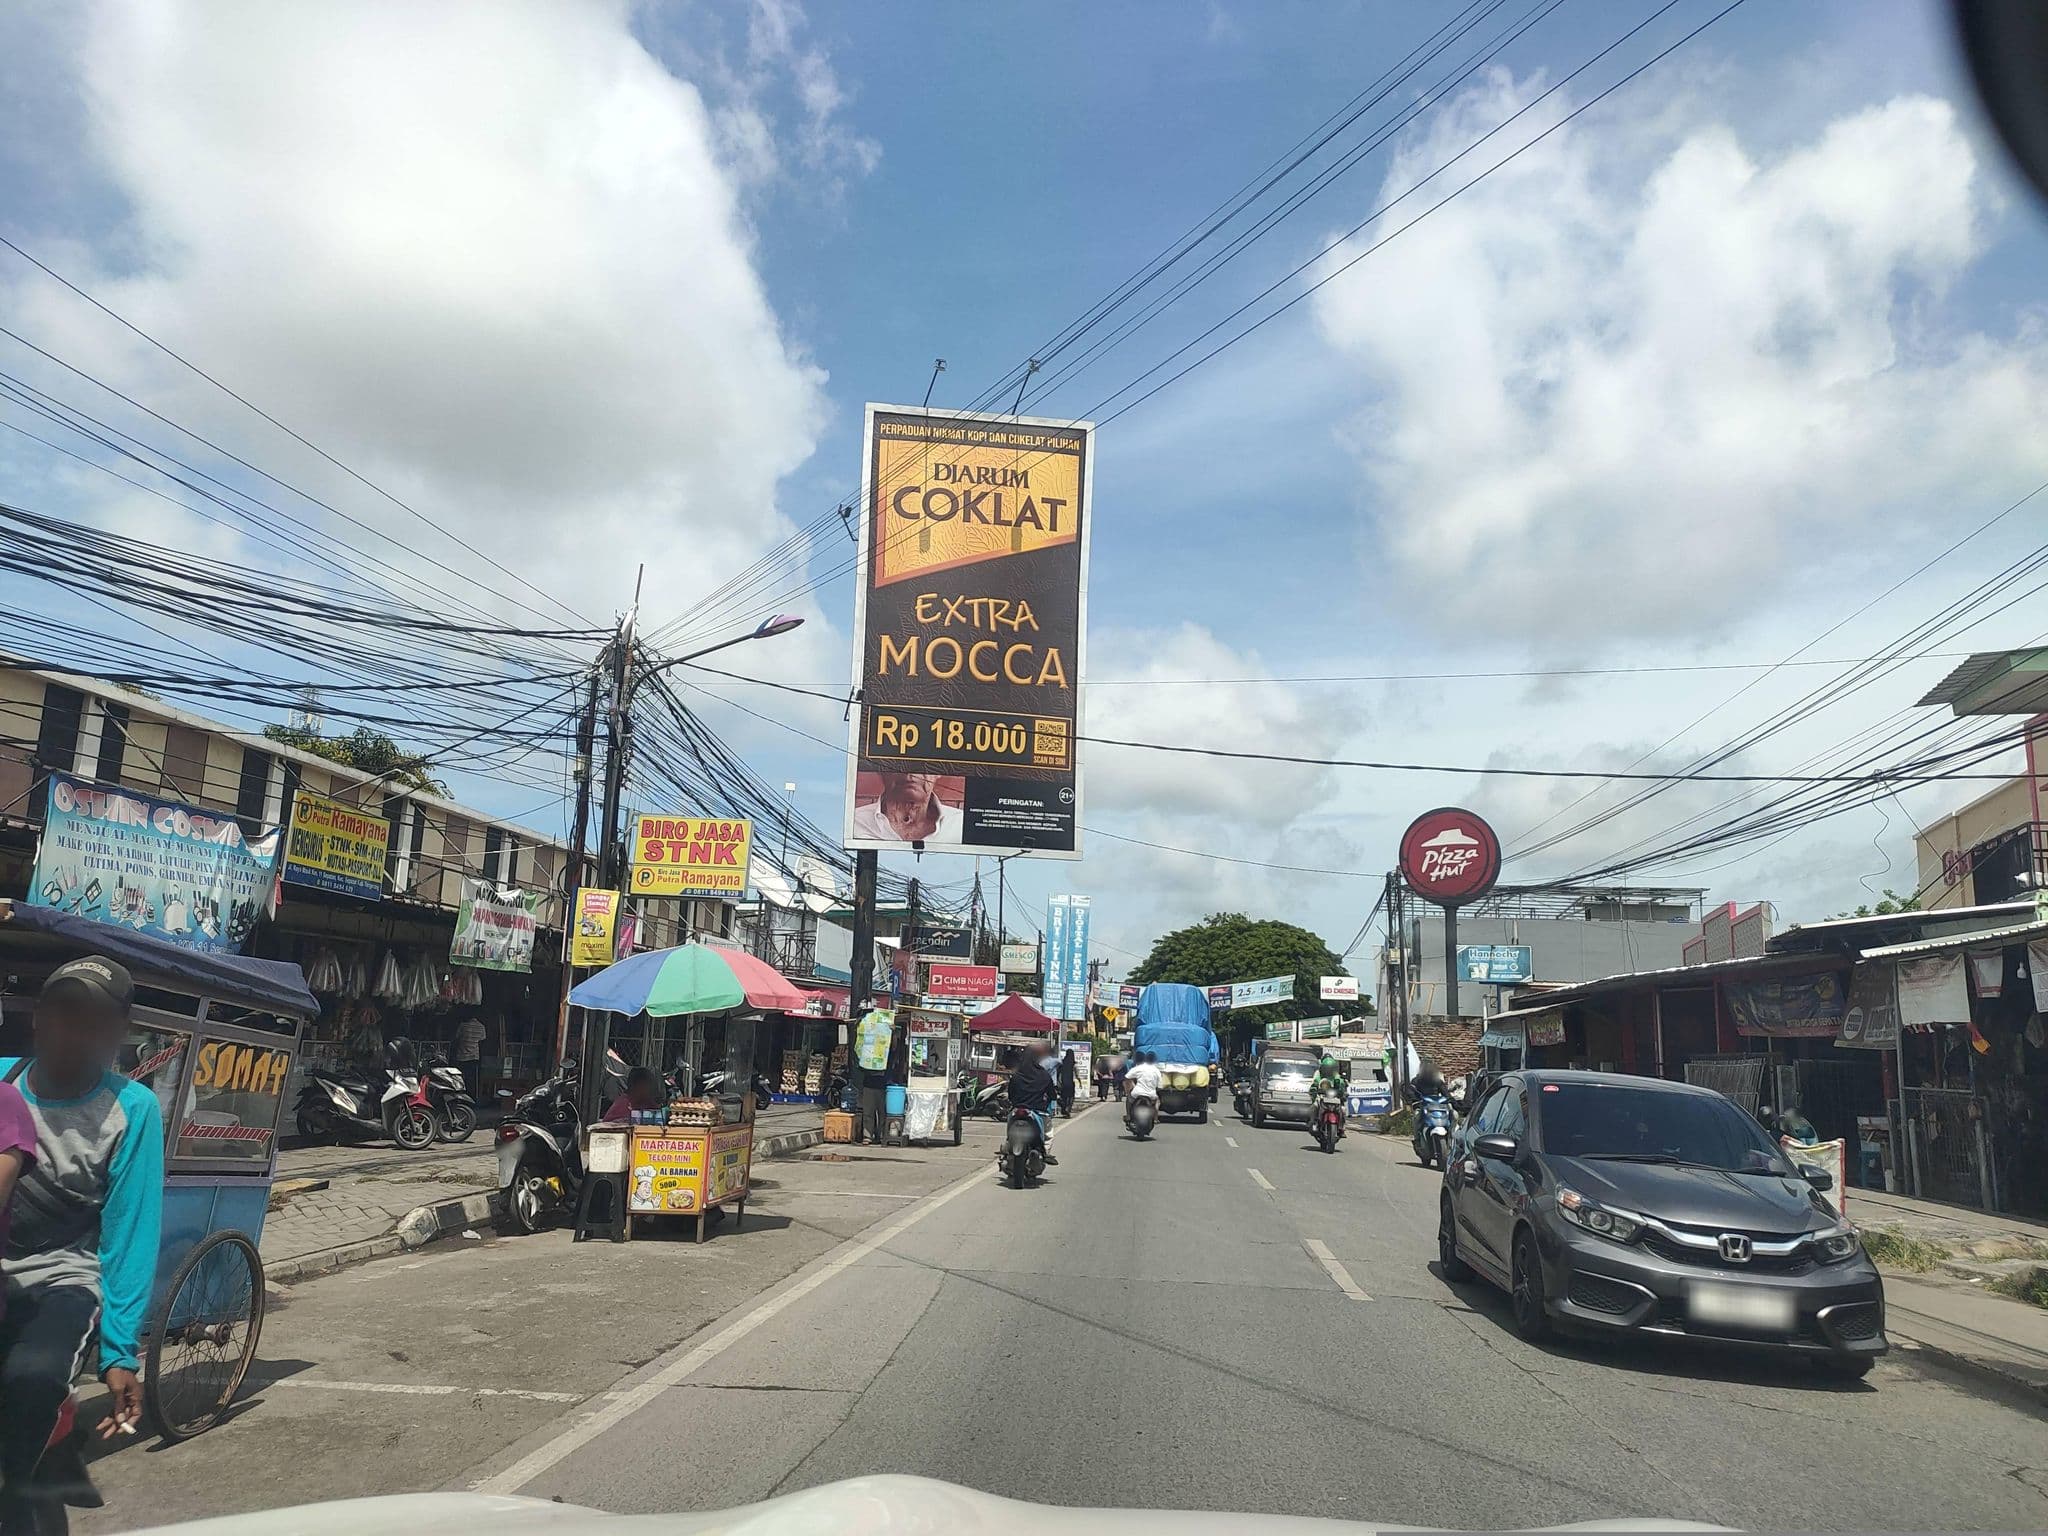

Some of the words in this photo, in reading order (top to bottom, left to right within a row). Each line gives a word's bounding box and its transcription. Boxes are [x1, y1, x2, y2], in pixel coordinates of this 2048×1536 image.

[880, 423, 930, 437] PERPADUAN
[932, 426, 965, 440] NIKMAT
[989, 431, 1007, 444] DAN
[1008, 433, 1046, 447] COKELAT
[1047, 437, 1080, 451] PILIHAN
[933, 463, 1030, 489] DJARUM
[893, 485, 1067, 532] COKLAT
[915, 593, 1040, 633] EXTRA
[878, 634, 1070, 689] MOCCA
[876, 715, 919, 754] Rp
[930, 718, 1027, 755] 18.000
[54, 781, 150, 830] OSHIN
[66, 820, 127, 841] MENJUAL
[312, 811, 330, 826] Putra
[331, 806, 387, 843] Ramayana
[640, 819, 689, 840] BIRO
[694, 822, 745, 842] JASA
[56, 835, 83, 851] MAKE
[85, 840, 114, 857] OVER,
[643, 839, 739, 866] STNK
[1421, 845, 1479, 873] Pizza
[83, 855, 124, 873] ULTIMA,
[125, 861, 158, 879] PONDS,
[657, 875, 680, 884] Putra
[681, 869, 740, 888] Ramayana
[1430, 860, 1472, 882] Hut
[1073, 908, 1085, 948] DIGITAL
[1049, 940, 1061, 981] LINK
[1072, 952, 1083, 982] PRINT
[1468, 948, 1520, 959] Hannochs
[943, 976, 967, 985] CIMB
[967, 976, 994, 986] NIAGA
[193, 1040, 288, 1096] SOMAY
[179, 1117, 275, 1148] bandung
[640, 1139, 700, 1151] MARTABAK
[648, 1153, 672, 1162] TELOR
[674, 1155, 691, 1163] MINI
[659, 1167, 669, 1176] AL
[669, 1167, 698, 1177] BARKAH
[659, 1180, 678, 1190] 5000
